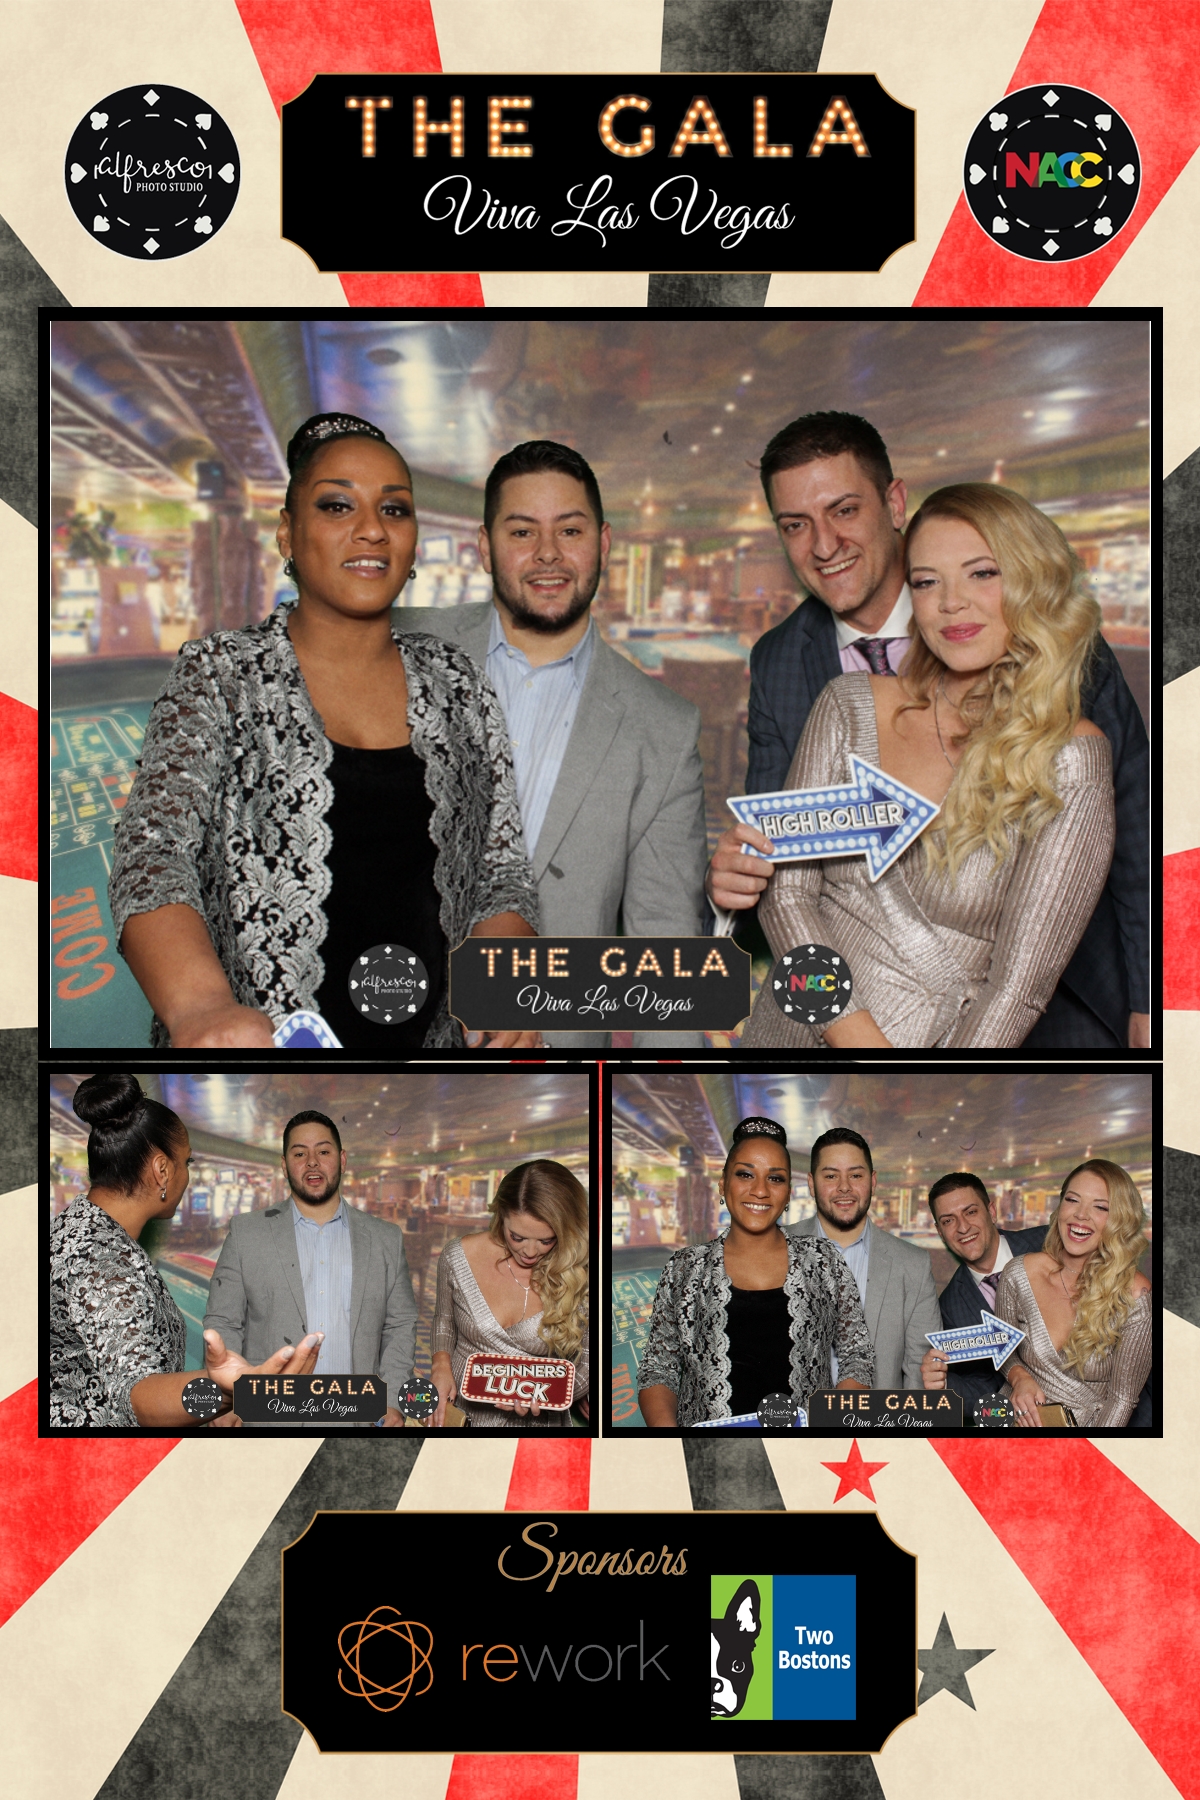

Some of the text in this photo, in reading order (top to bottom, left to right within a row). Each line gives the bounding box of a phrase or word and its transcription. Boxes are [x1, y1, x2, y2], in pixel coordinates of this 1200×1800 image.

[761, 801, 903, 837] HIGH ROLLER
[941, 1333, 1009, 1352] HIGH ROLLER
[472, 1364, 567, 1378] BEGINNERS
[485, 1376, 551, 1402] LUCK
